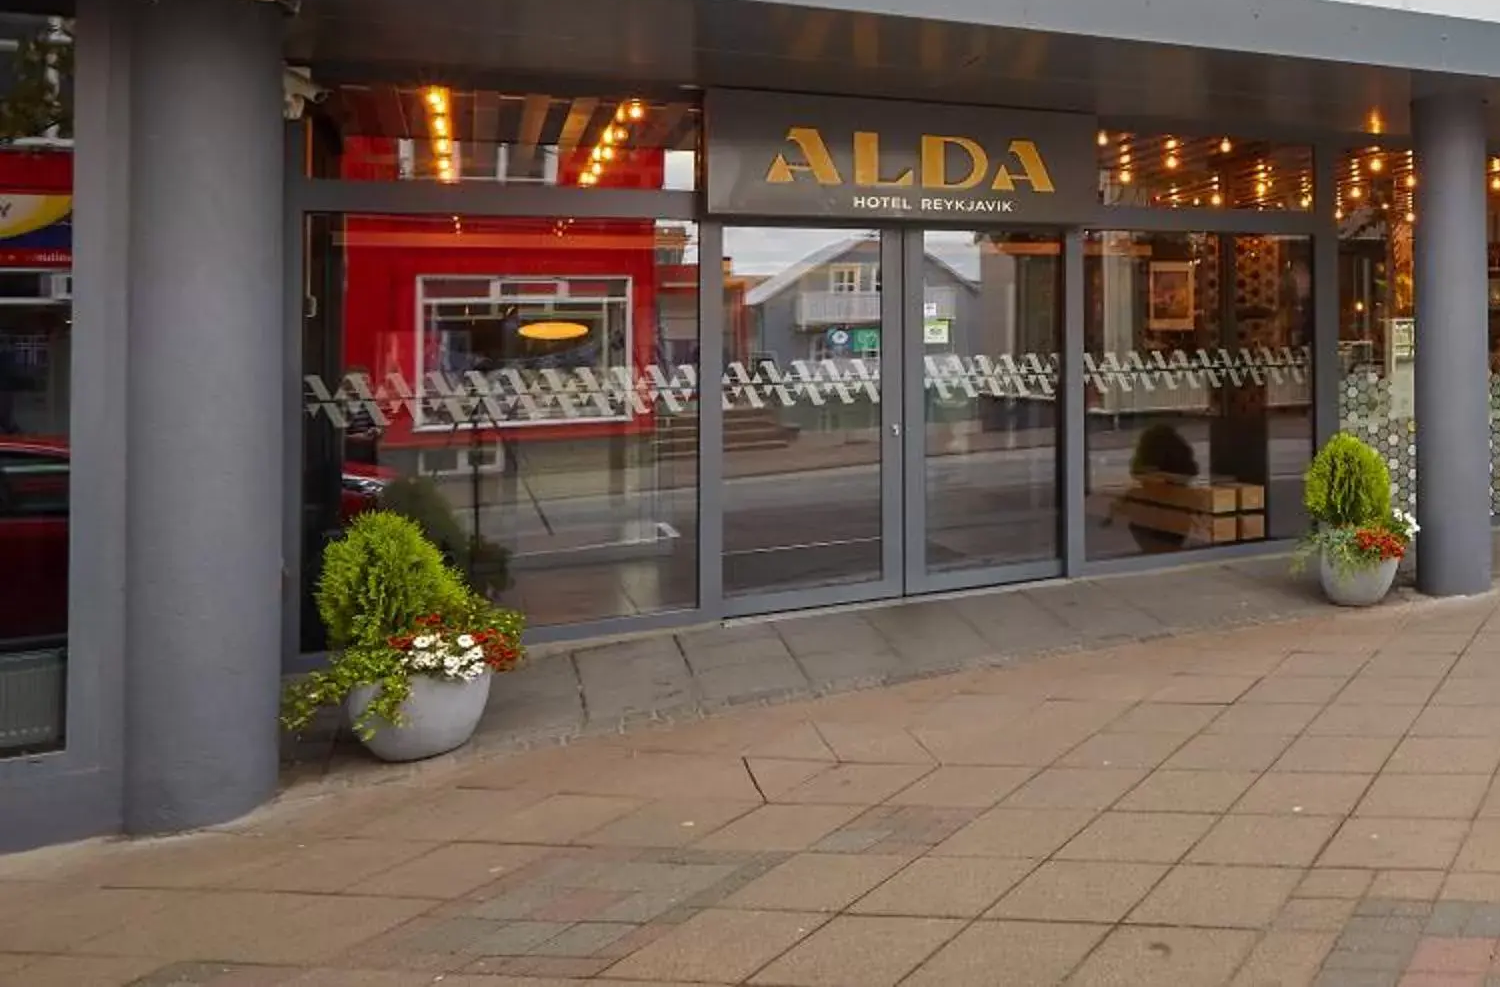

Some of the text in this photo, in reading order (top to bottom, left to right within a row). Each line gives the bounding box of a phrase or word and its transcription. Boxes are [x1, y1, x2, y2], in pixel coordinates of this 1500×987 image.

[766, 127, 1055, 193] ALDA
[853, 196, 1014, 213] HOTEL REYKJAVIK
